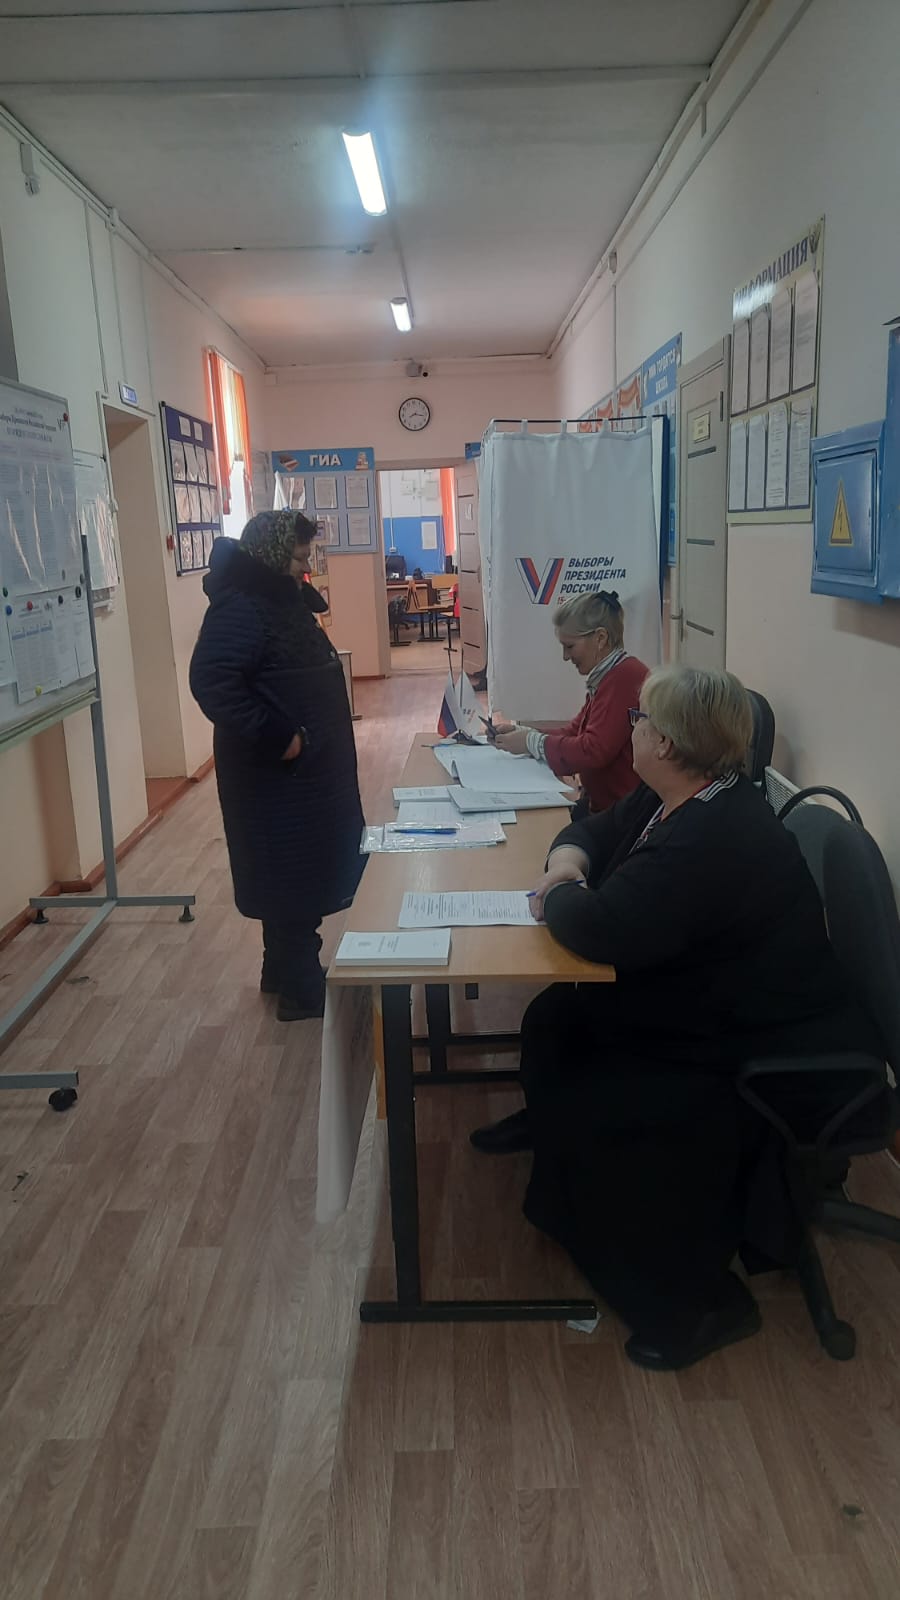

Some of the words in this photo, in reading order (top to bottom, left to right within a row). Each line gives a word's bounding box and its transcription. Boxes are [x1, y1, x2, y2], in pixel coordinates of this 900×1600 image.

[309, 454, 342, 467] ГИА
[568, 556, 615, 568] ВЫБОРЫ
[564, 569, 627, 581] ПРЕЗИДЕНТА
[560, 583, 601, 594] РОССИИ
